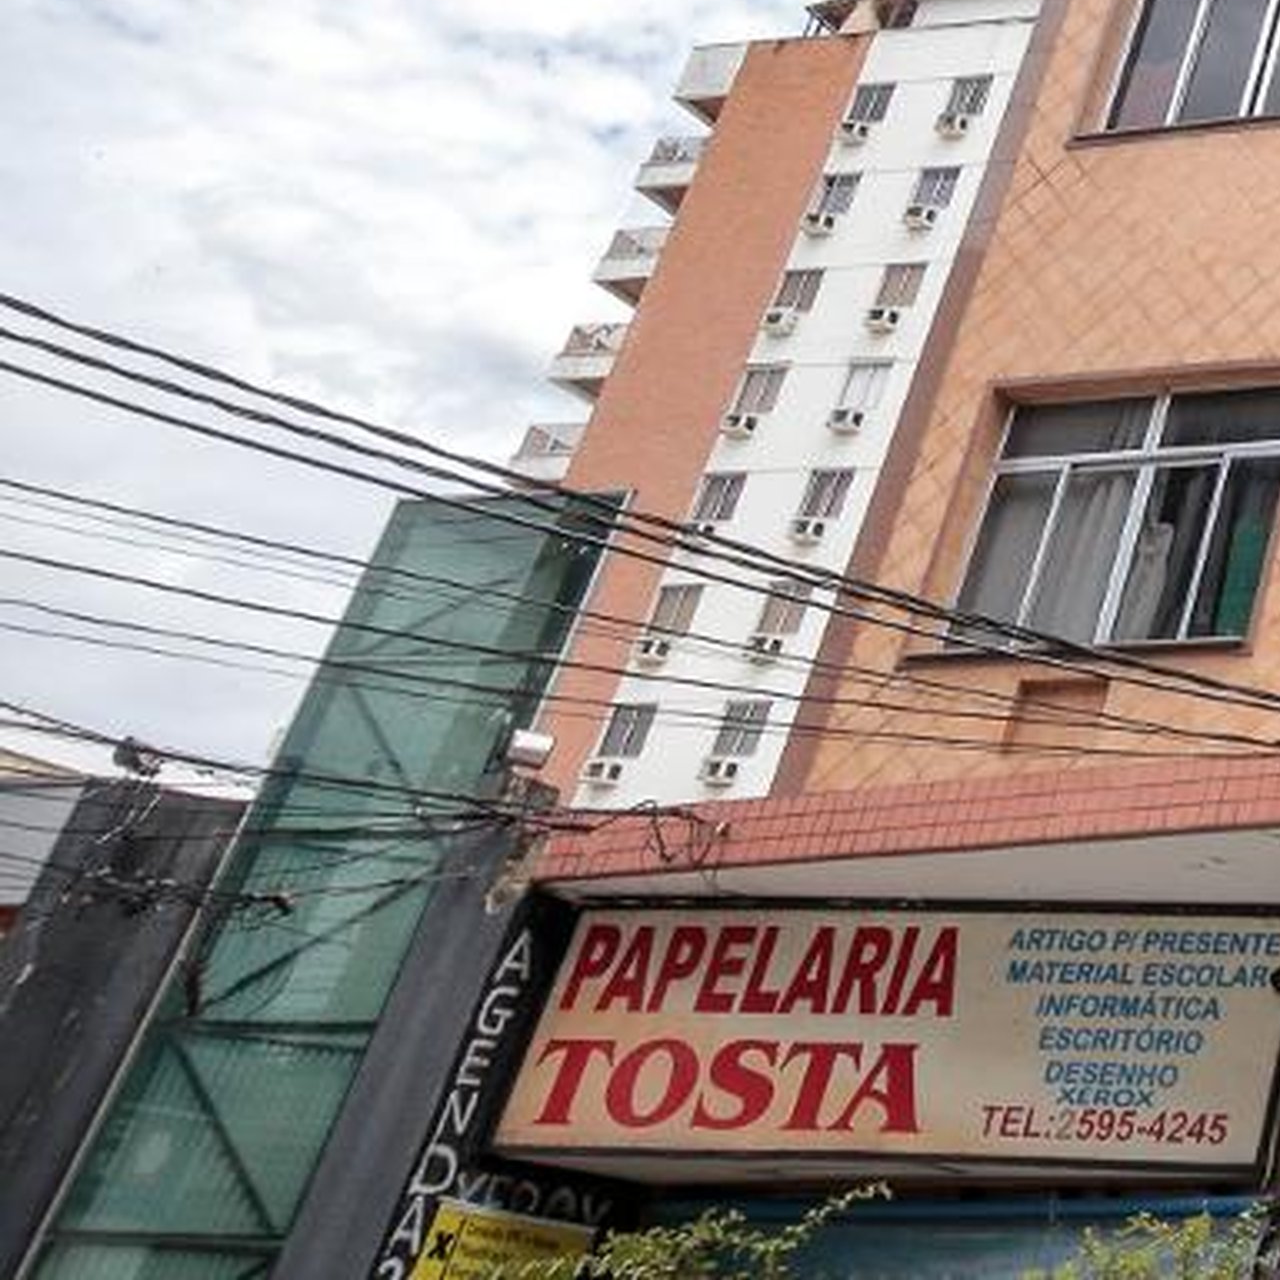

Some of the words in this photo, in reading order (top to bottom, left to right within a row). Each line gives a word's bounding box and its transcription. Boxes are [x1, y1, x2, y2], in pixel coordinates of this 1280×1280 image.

[1009, 928, 1107, 952] ARTIGO
[564, 923, 960, 1018] PAPELARIA
[1006, 960, 1134, 985] MATERIAL
[1141, 962, 1270, 988] ESCOLAR
[1036, 991, 1221, 1021] INFORMÁTICA
[1038, 1023, 1204, 1055] ESCRITÓRIO
[532, 1038, 919, 1135] TOSTA
[1045, 1060, 1180, 1088] DESENHO
[1056, 1087, 1155, 1109] XEROX
